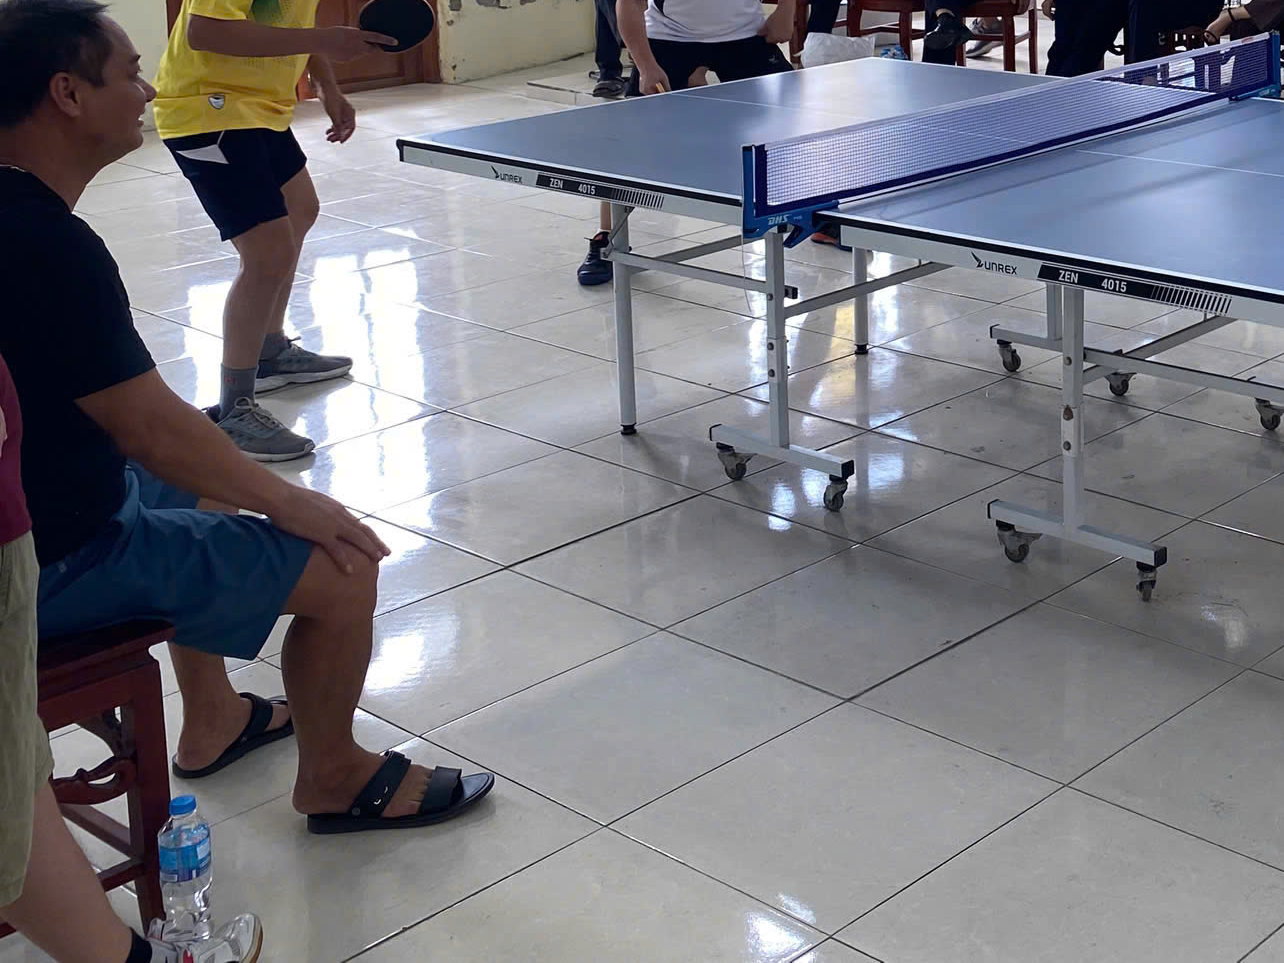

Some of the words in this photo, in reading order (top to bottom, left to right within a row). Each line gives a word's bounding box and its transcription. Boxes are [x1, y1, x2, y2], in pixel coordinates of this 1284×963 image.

[550, 178, 564, 189] ZEN
[578, 183, 596, 195] 4015
[1058, 269, 1079, 283] ZEN
[1101, 278, 1127, 293] 4015
